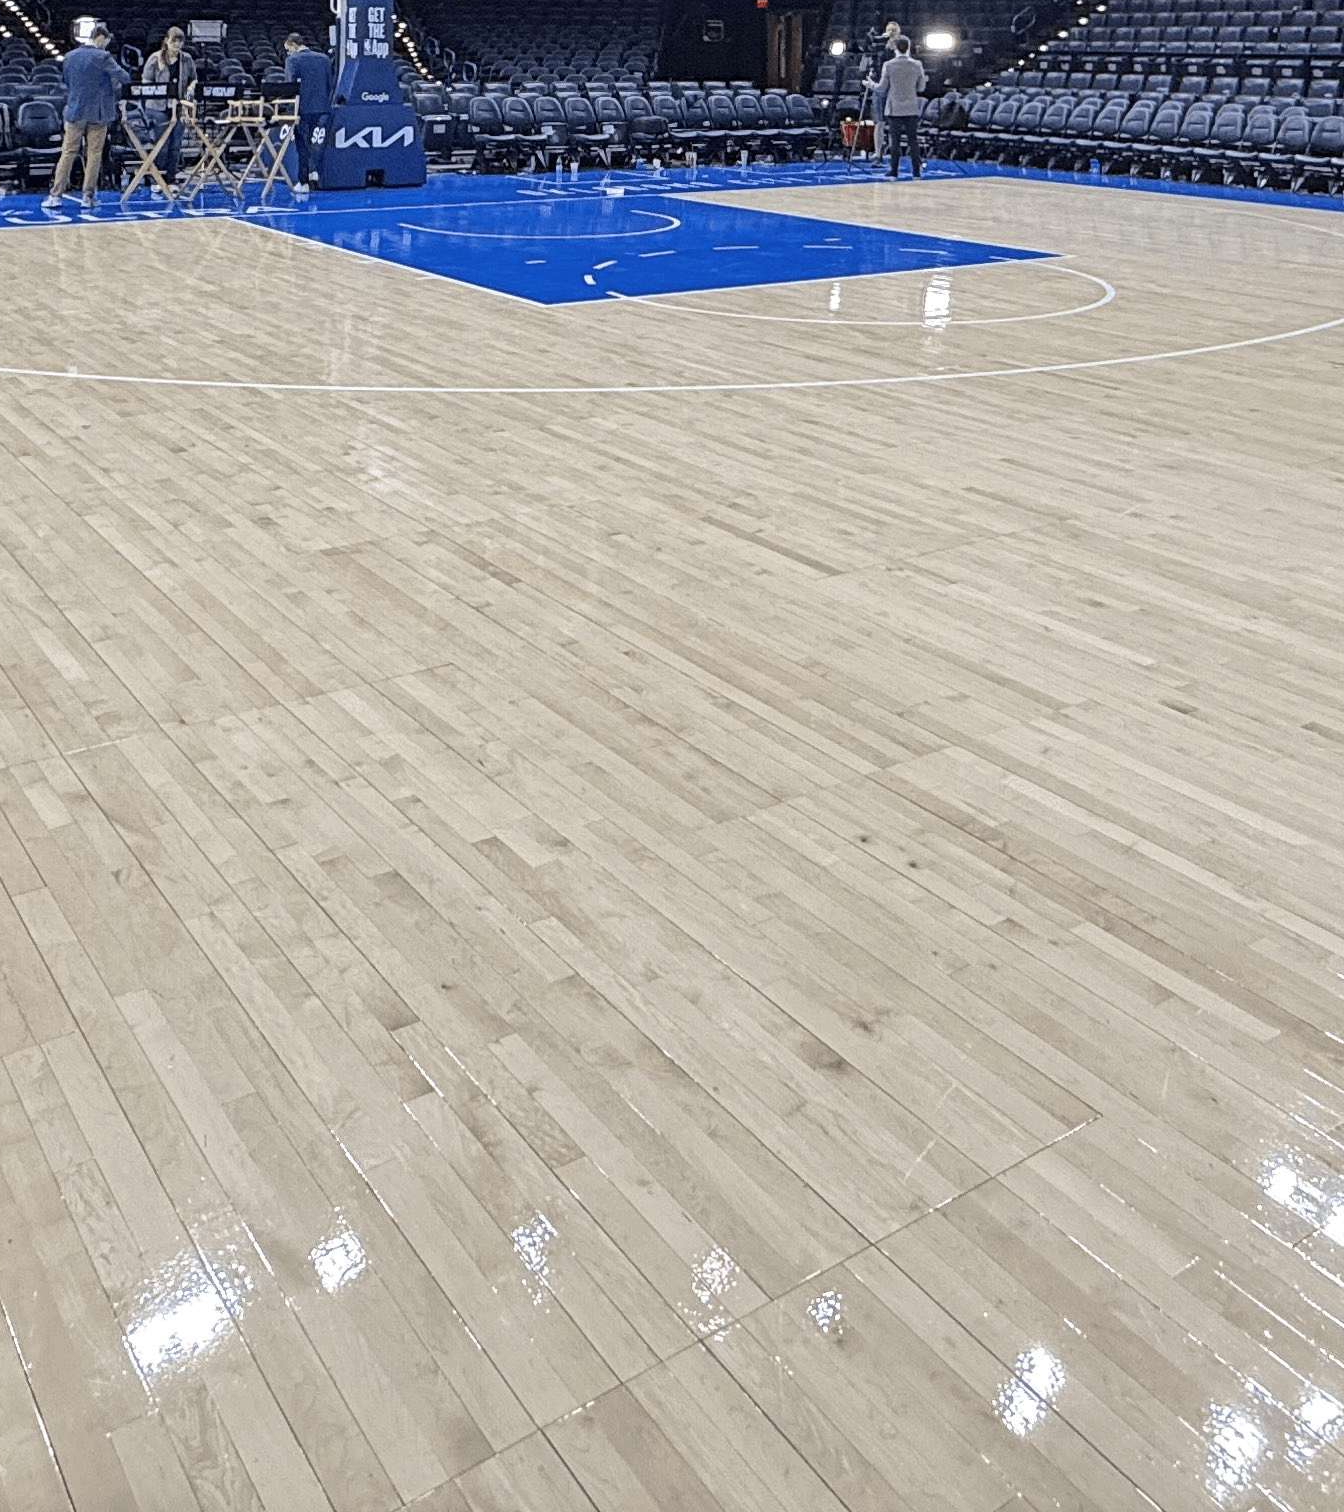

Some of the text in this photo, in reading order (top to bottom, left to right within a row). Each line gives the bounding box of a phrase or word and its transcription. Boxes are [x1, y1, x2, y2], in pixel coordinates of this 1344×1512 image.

[368, 7, 385, 22] GET
[368, 23, 385, 38] THE
[372, 39, 389, 59] App
[361, 92, 390, 103] Google
[335, 126, 414, 149] KIA
